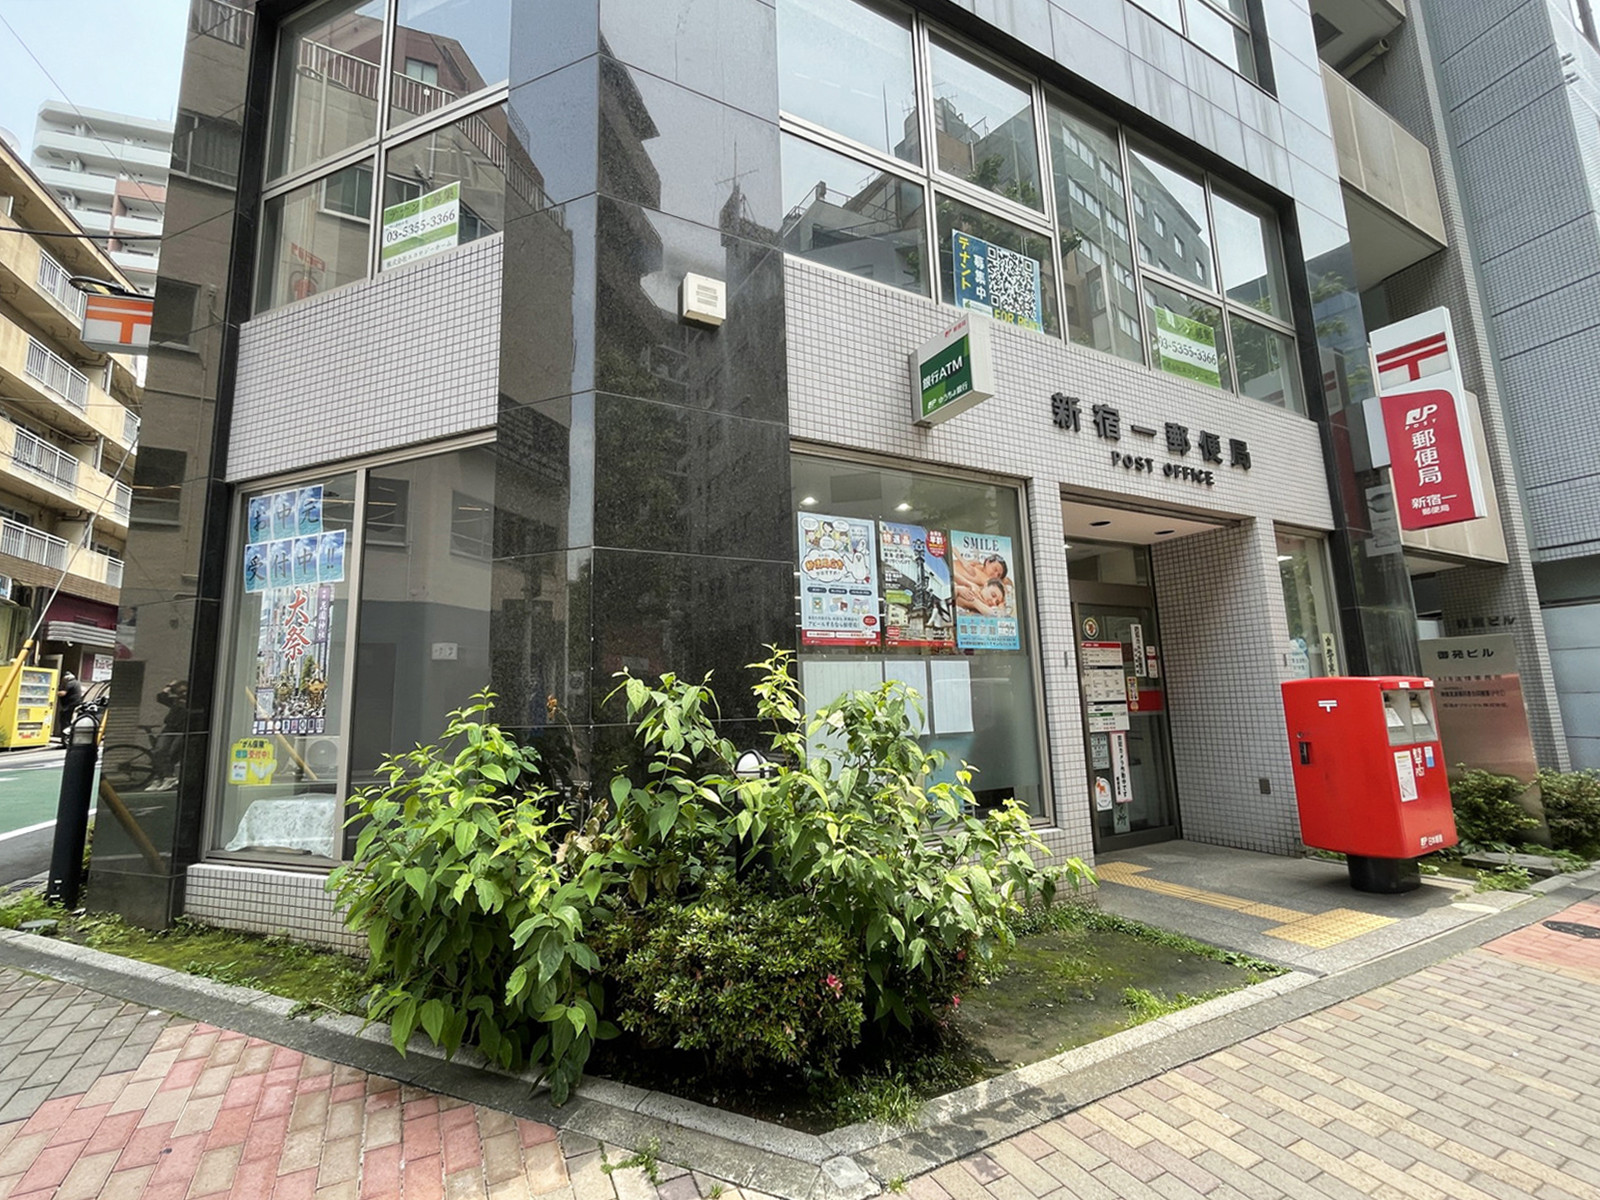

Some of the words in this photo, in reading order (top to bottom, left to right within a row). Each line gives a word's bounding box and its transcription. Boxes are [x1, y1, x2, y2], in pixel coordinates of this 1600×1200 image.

[386, 209, 456, 243] 03-5355-3366
[959, 237, 972, 290] テナント
[994, 309, 1015, 325] FOR
[922, 355, 963, 390] 銀行ATM
[1051, 392, 1252, 472] 新宿一郵便局
[1111, 450, 1154, 473] POST
[1163, 462, 1215, 487] OFFICE
[1411, 428, 1443, 487] 郵便局
[252, 500, 320, 532] お中元
[1411, 494, 1458, 510] 新宿一
[1421, 505, 1450, 516] 郵便局
[963, 536, 1000, 552] SMILE
[248, 547, 334, 582] 受付中!!
[282, 589, 310, 660] 大祭
